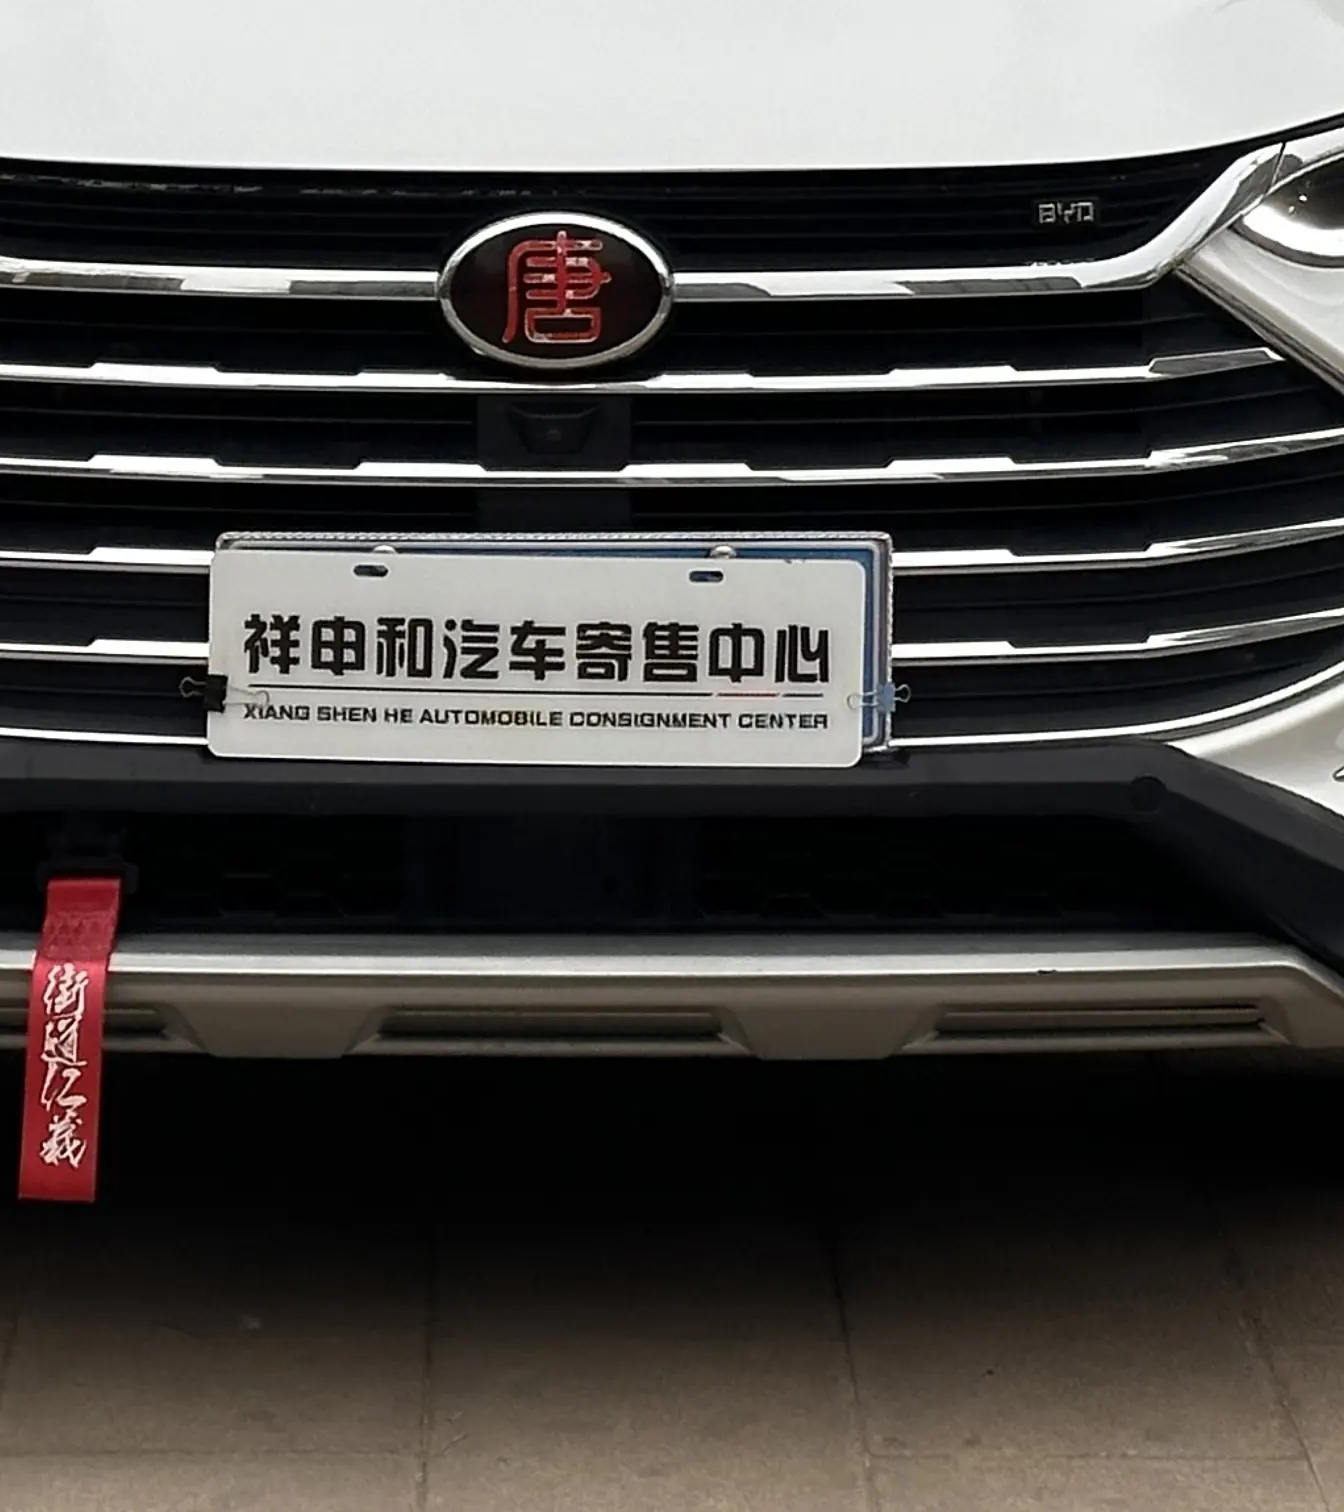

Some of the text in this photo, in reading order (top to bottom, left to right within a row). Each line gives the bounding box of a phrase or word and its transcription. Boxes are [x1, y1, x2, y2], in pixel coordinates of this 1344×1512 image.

[1038, 201, 1095, 224] BYD
[501, 229, 613, 345] 唐
[243, 613, 830, 683] 祥申和汽车寄售中心
[243, 702, 829, 730] XIANG SHEN HE AUTOMOBILE CONSIGNMENT CENTER
